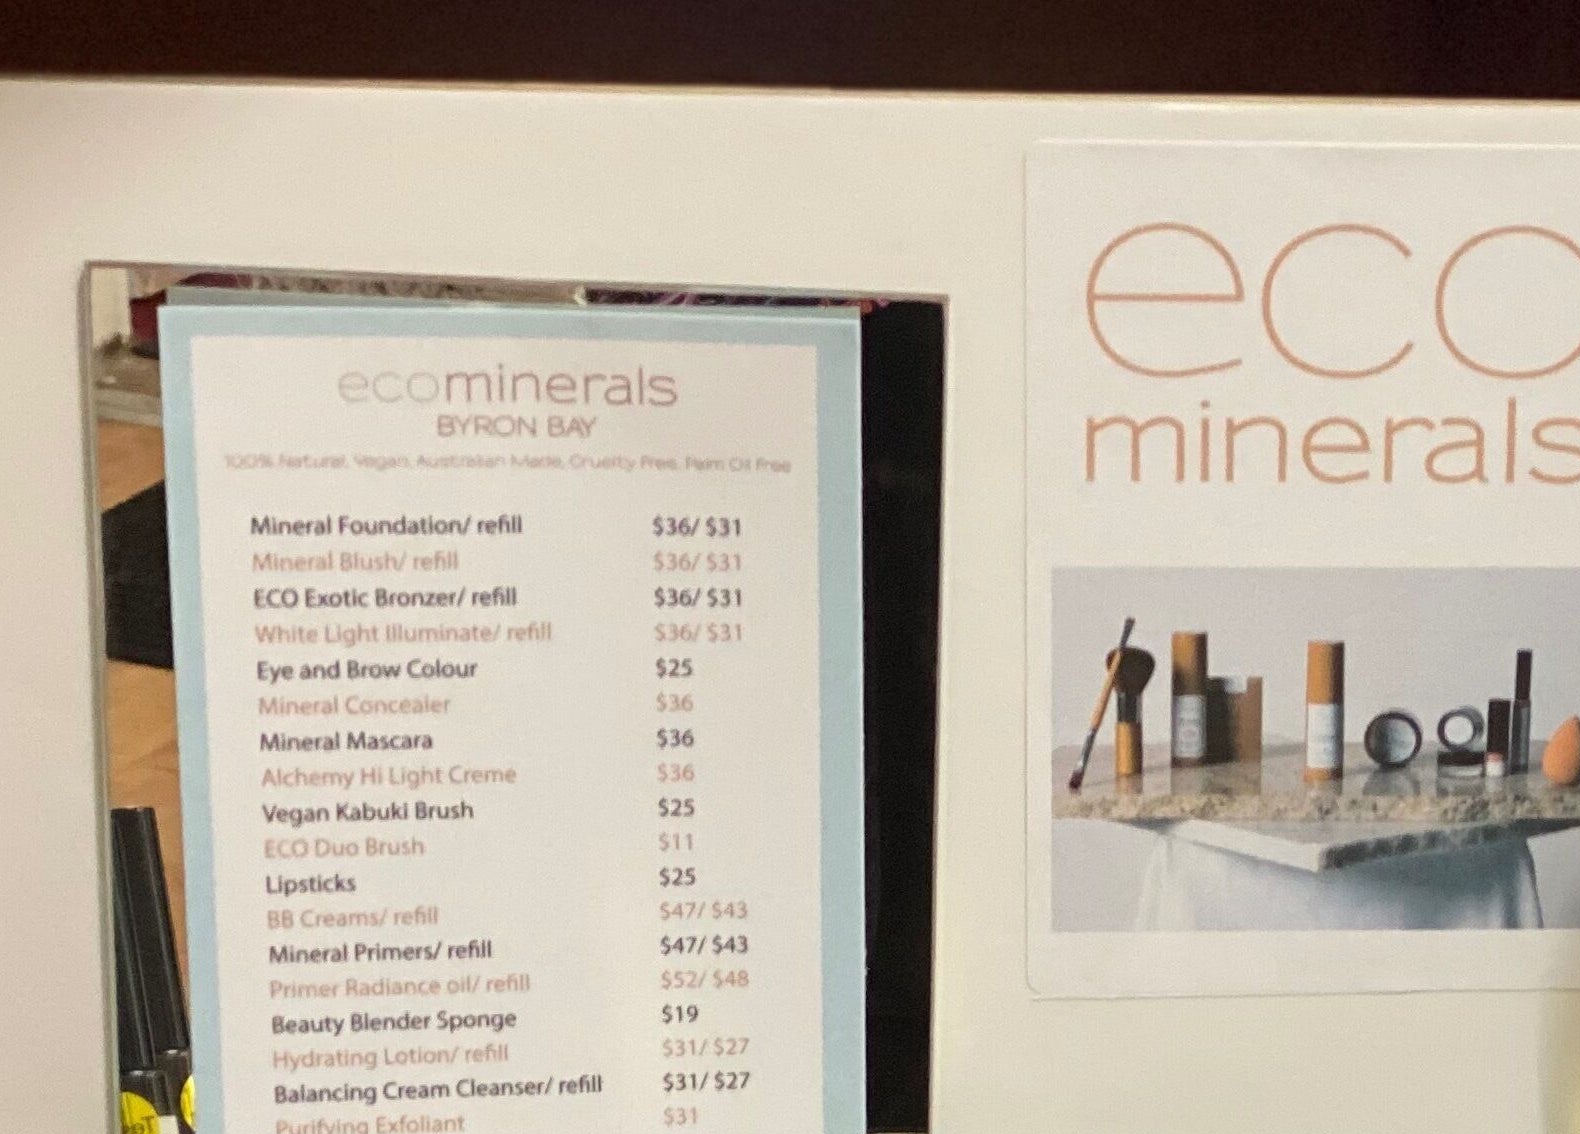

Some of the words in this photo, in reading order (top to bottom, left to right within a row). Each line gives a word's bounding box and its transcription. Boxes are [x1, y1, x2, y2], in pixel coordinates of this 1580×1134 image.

[437, 413, 537, 438] BYRON
[547, 415, 597, 439] BAY
[251, 515, 332, 537] Mineral
[338, 515, 471, 536] Foundation/
[477, 514, 522, 535] refill
[653, 515, 700, 537] $36/
[706, 516, 741, 538] $31
[252, 549, 334, 572] Mineral
[340, 551, 407, 572] Blush/
[413, 550, 459, 571] refill
[653, 550, 701, 573] $36/
[707, 551, 741, 573] $31
[254, 587, 299, 610] ECO
[305, 587, 368, 609] Exotic
[375, 587, 466, 608] Bronzer/
[472, 586, 517, 607] refill
[654, 586, 701, 608] $36/
[707, 587, 741, 608] $31
[254, 624, 318, 644] White
[324, 623, 379, 649] Light
[386, 623, 501, 644] Illuminate/
[507, 621, 552, 642] refill
[654, 622, 701, 642] $36/
[707, 621, 742, 643] $31
[257, 661, 294, 685] Eye
[299, 660, 341, 680] and
[347, 659, 401, 680] Brow
[406, 658, 478, 679] Colour
[656, 657, 693, 679] $25
[258, 695, 339, 716] Mineral
[344, 694, 451, 715] Concealer
[656, 691, 694, 713] $36
[260, 732, 340, 752] Mineral
[347, 730, 433, 751] Mascara
[657, 727, 694, 749] $36
[261, 767, 355, 790] Alchemy
[360, 766, 383, 785] Hi
[389, 765, 442, 790] Light
[448, 764, 517, 785] Creme
[658, 762, 695, 784] $36
[262, 804, 330, 829] Vegan
[336, 801, 408, 822] Kabuki
[415, 800, 474, 820] Brush
[658, 796, 695, 818] $25
[264, 837, 309, 860] ECO
[314, 837, 359, 858] Duo
[365, 836, 425, 858] Brush
[659, 832, 693, 853] $11
[266, 873, 356, 897] Lipsticks
[659, 867, 696, 888] $25
[267, 909, 294, 930] BB
[300, 908, 387, 929] Creams/
[394, 905, 438, 926] refill
[660, 901, 706, 921] $47/
[712, 900, 748, 920] $43
[269, 943, 348, 964] Mineral
[354, 941, 442, 962] Primers/
[448, 939, 492, 960] refill
[661, 935, 706, 956] $47/
[712, 934, 748, 956] $43
[269, 979, 339, 1000] Primer
[345, 977, 441, 997] Radiance
[447, 974, 480, 995] oil/
[486, 973, 530, 994] refill
[661, 969, 706, 991] $52/
[713, 969, 749, 990] $48
[272, 1015, 344, 1037] Beauty
[350, 1011, 430, 1032] Blender
[437, 1010, 517, 1034] Sponge
[662, 1004, 699, 1025] $19
[273, 1049, 378, 1075] Hydrating
[384, 1046, 459, 1066] Lotion/
[465, 1042, 508, 1064] refill
[662, 1037, 708, 1059] $31/
[714, 1036, 750, 1058] $27
[274, 1083, 377, 1106] Balancing
[382, 1081, 450, 1100] Cream
[456, 1076, 553, 1099] Cleanser/
[559, 1074, 603, 1095] refill
[663, 1072, 708, 1094] $31/
[714, 1070, 750, 1092] $27
[664, 1106, 698, 1128] $31
